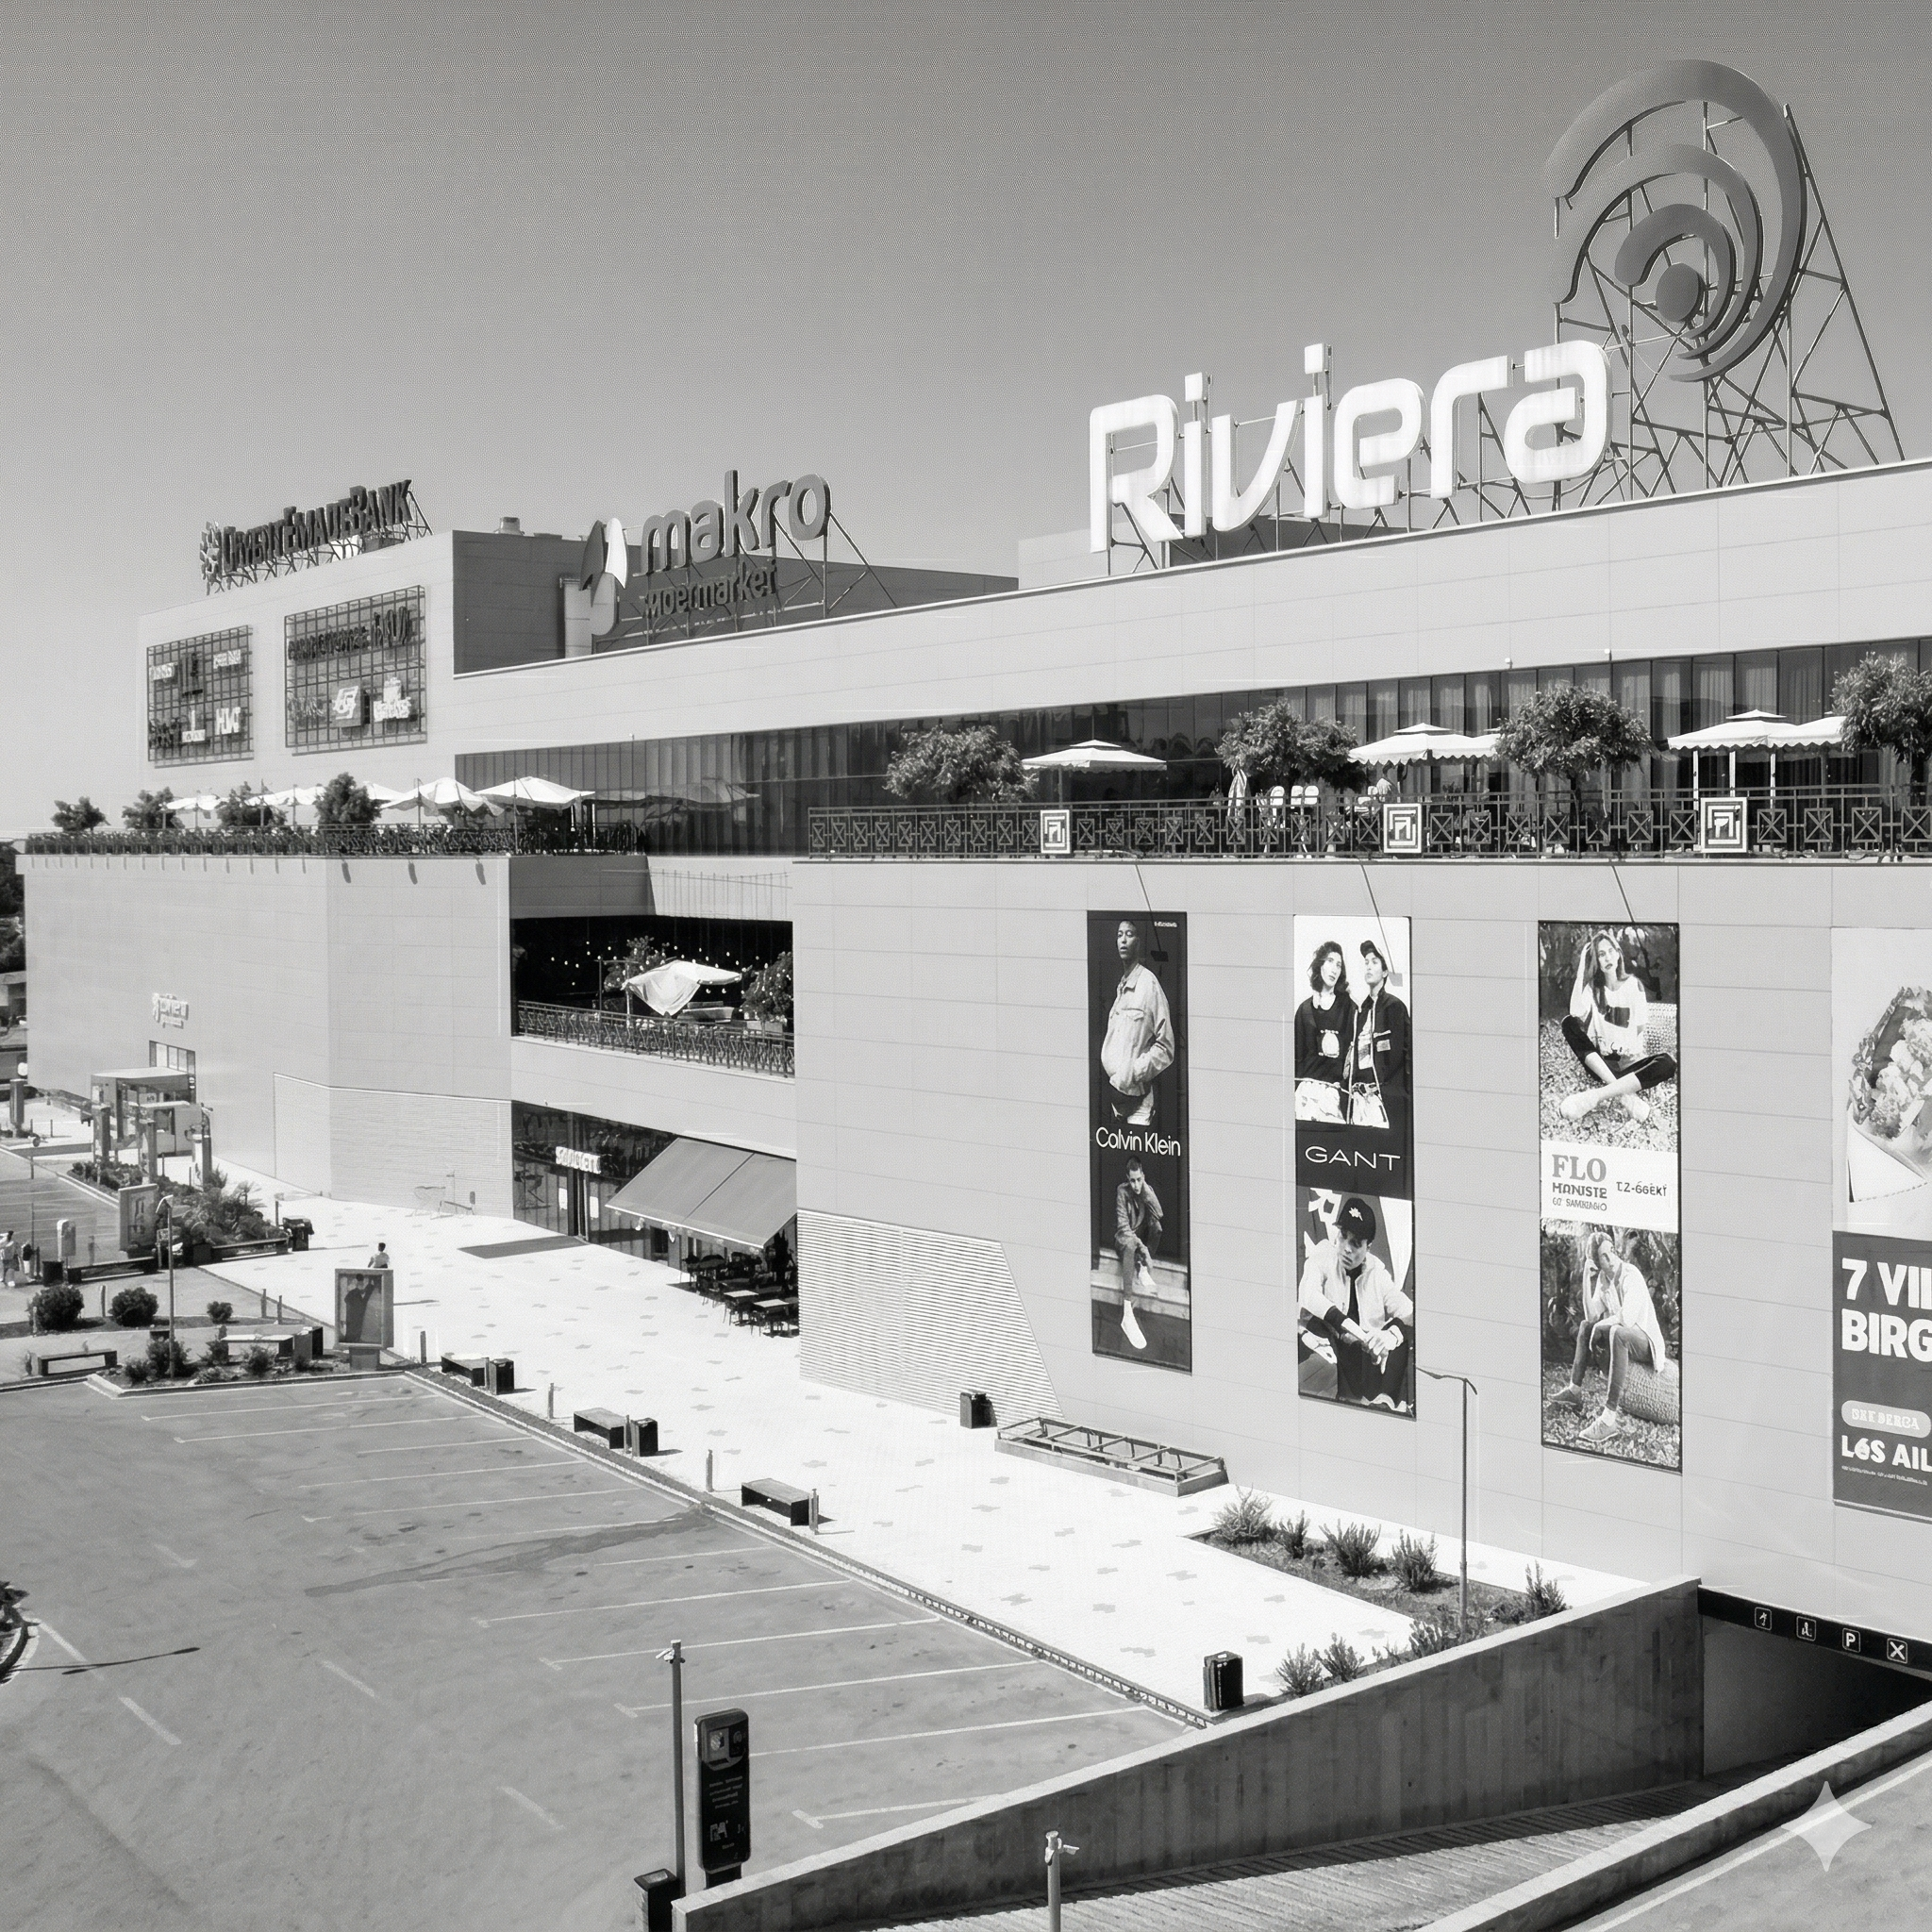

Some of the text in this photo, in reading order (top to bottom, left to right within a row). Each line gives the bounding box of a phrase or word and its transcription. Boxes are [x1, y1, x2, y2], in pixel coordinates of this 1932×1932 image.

[1090, 340, 1612, 554] Riviera
[633, 469, 831, 576] makro
[1095, 1126, 1181, 1157] Calvin Klein
[1305, 1145, 1401, 1171] GANT
[1552, 1154, 1607, 1182] FLO
[1841, 1257, 1868, 1301] 7
[1841, 1308, 1932, 1362] BIRG
[1845, 1632, 1856, 1647] P
